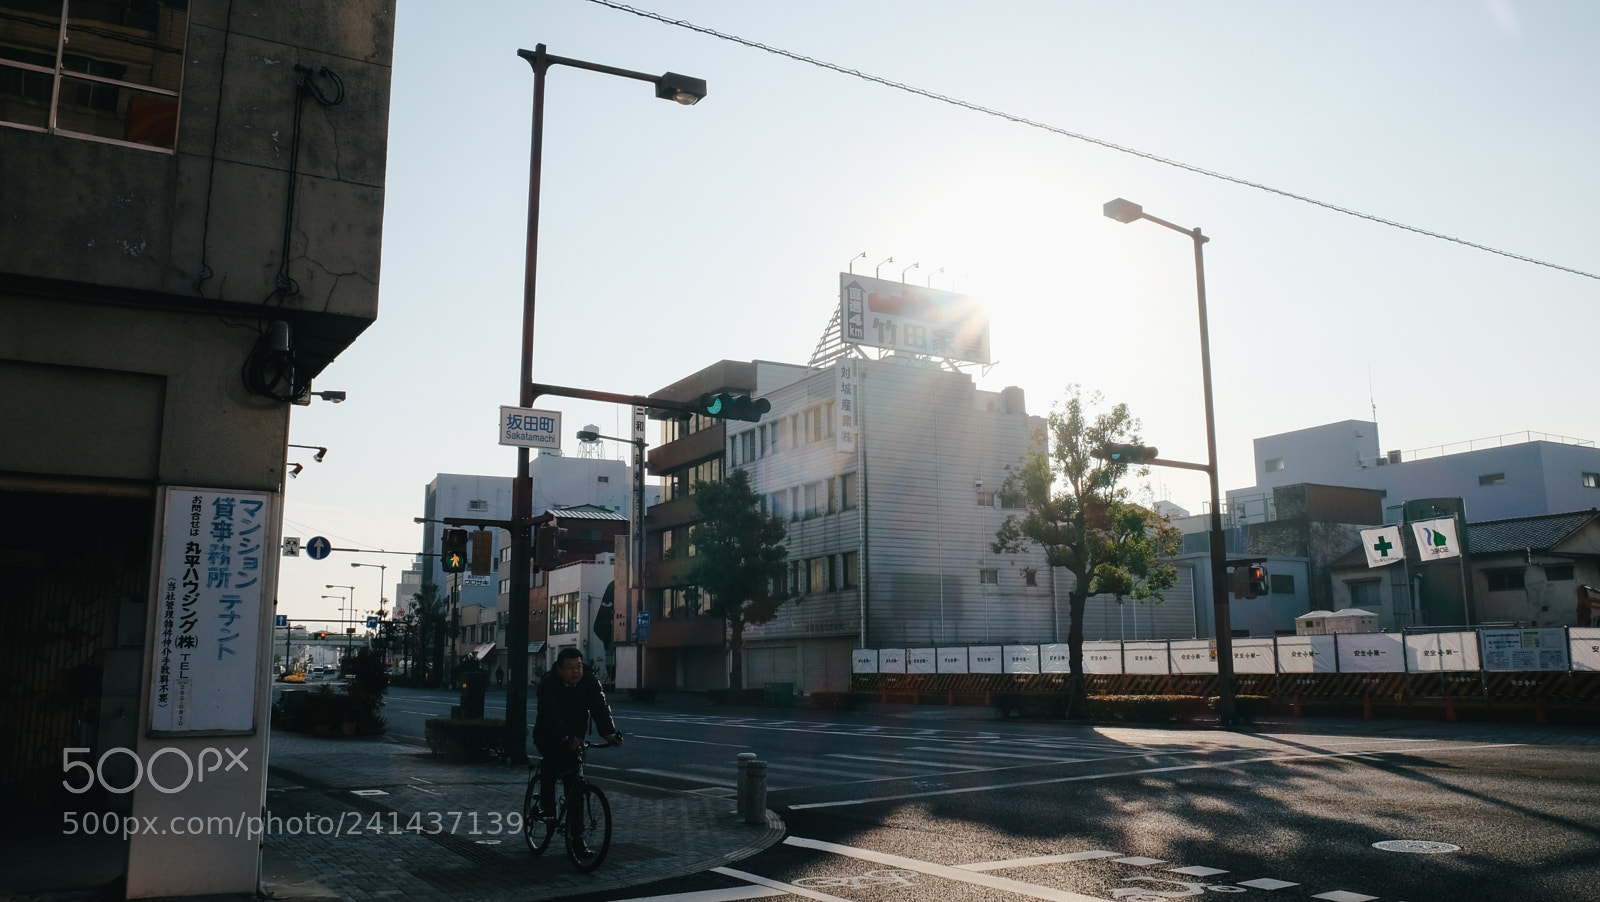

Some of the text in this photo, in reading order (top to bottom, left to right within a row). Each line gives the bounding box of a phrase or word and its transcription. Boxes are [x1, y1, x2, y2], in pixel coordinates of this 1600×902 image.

[505, 430, 556, 443] Sakatamachi
[506, 413, 556, 434] 坂田町
[189, 495, 203, 537] お問合せは
[206, 497, 236, 589] 貸事務所
[234, 499, 264, 589] マンション
[217, 594, 243, 661] テナント
[179, 653, 191, 679] TEL
